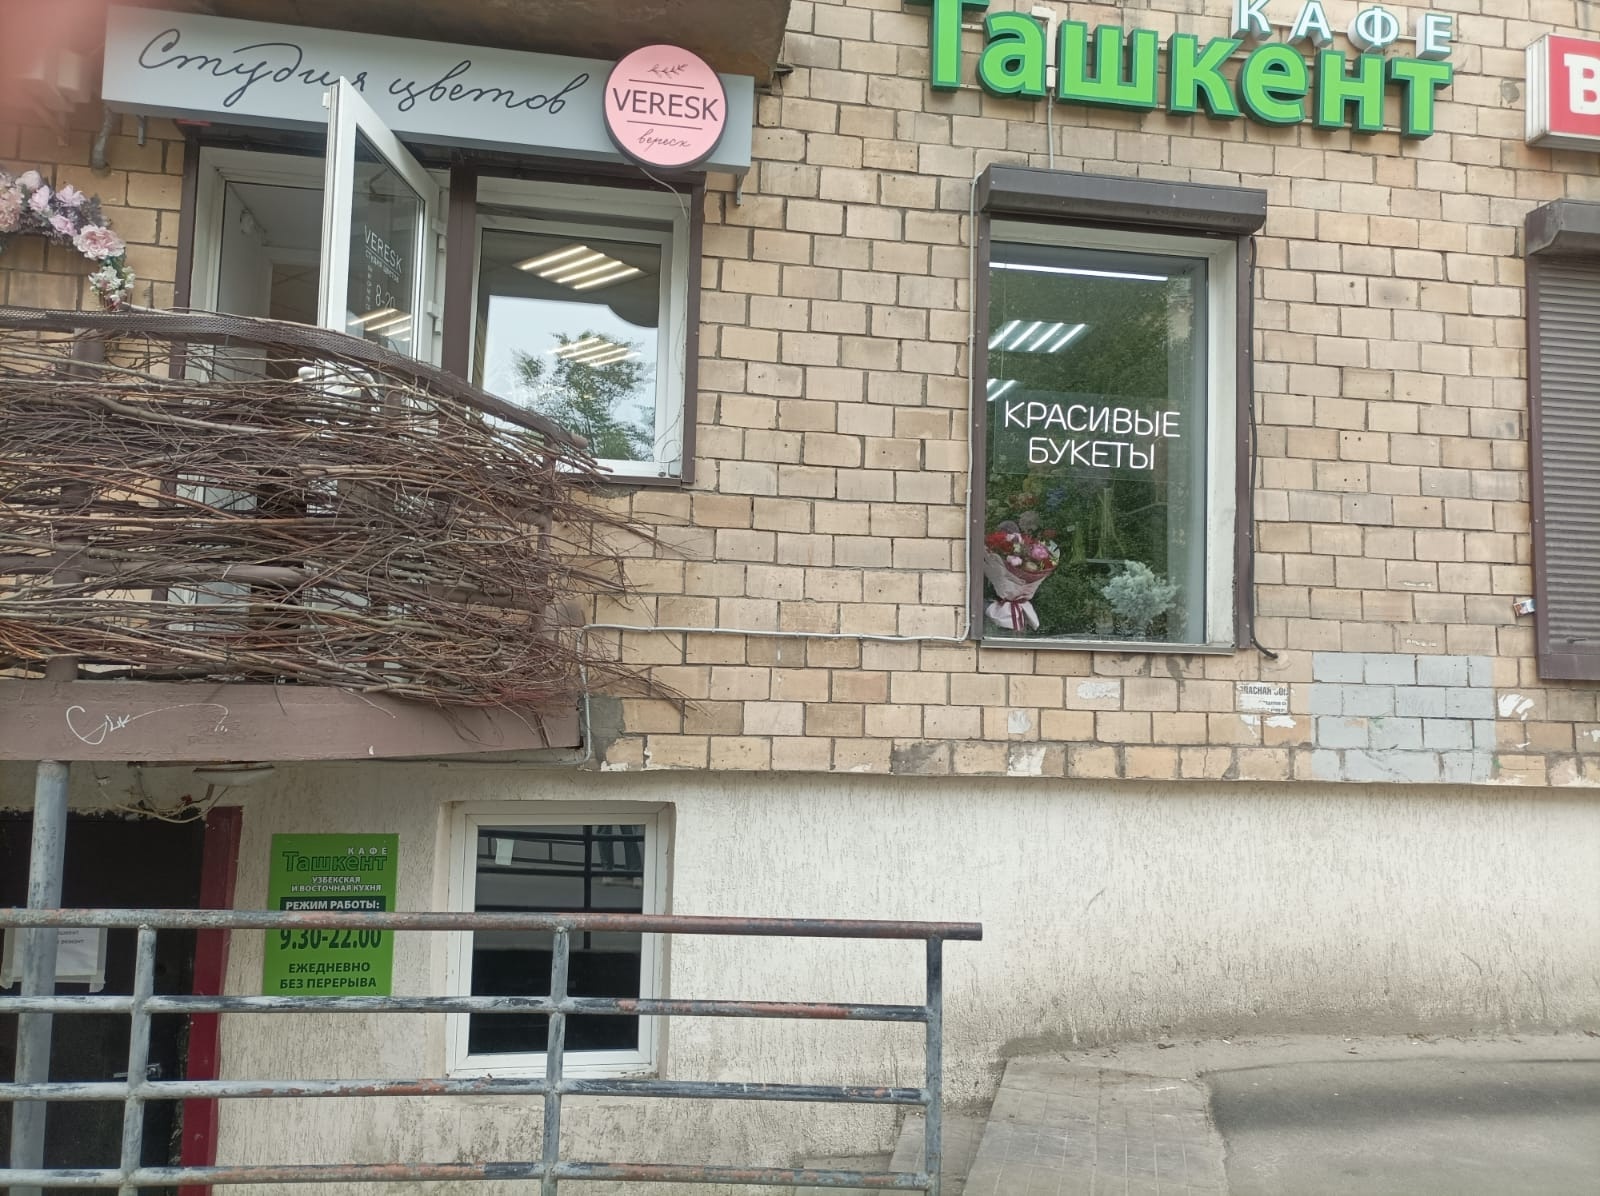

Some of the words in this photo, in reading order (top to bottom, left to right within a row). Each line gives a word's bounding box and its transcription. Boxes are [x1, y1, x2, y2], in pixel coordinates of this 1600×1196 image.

[1234, 0, 1453, 58] КАФЕ
[138, 28, 367, 107] Студия
[388, 59, 590, 114] цветов
[907, 0, 1453, 139] Ташкент
[612, 87, 719, 122] VERESK
[638, 128, 691, 152] вереск
[364, 223, 402, 273] VERESK
[1004, 399, 1181, 438] КРАСИВЫЕ
[1028, 437, 1155, 471] БУКЕТЫ
[282, 851, 387, 872] Ташкент
[348, 847, 388, 855] КАФЕ
[312, 876, 361, 884] УЗБЕКСКАЯ
[353, 884, 382, 892] КУХНЯ
[285, 900, 328, 910] РЕЖИМ
[330, 899, 380, 910] РАБОТЫ:
[280, 929, 382, 950] 9.30-22.00
[288, 961, 371, 975] ЕЖЕДНЕВНО
[280, 978, 304, 989] БЕЗ
[306, 977, 377, 989] ПЕРЕРЫВА
